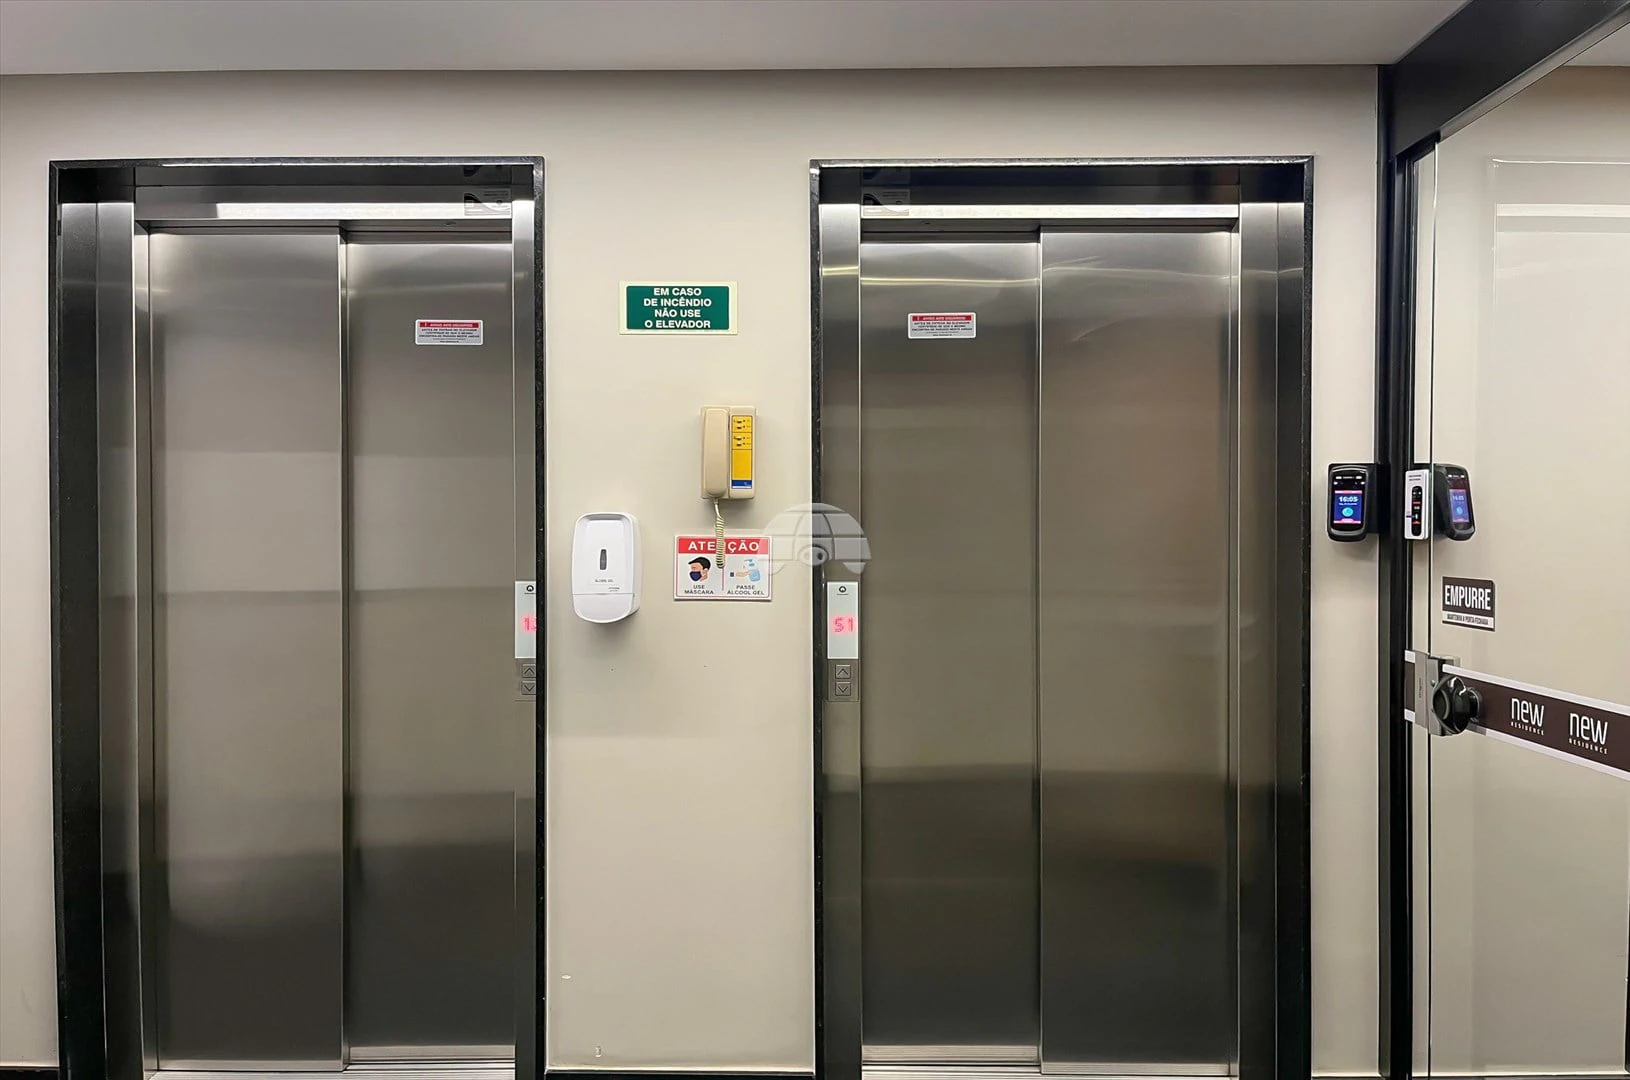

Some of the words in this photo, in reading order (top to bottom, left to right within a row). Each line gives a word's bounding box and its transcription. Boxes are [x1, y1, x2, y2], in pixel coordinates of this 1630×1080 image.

[653, 287, 670, 296] EM
[672, 287, 702, 296] CASO
[643, 298, 658, 307] DE
[660, 296, 712, 307] INCÊNDIO
[654, 308, 678, 318] NÃO
[680, 309, 701, 318] USE
[644, 320, 653, 329] O
[655, 320, 711, 329] ELEVADOR
[688, 540, 760, 553] ATEÇÃO
[1444, 584, 1492, 611] EMPURRE
[1511, 697, 1545, 727] new
[1510, 721, 1545, 736] RESIDENCE
[1569, 712, 1609, 745] new
[1568, 738, 1608, 755] RESIDENCE
